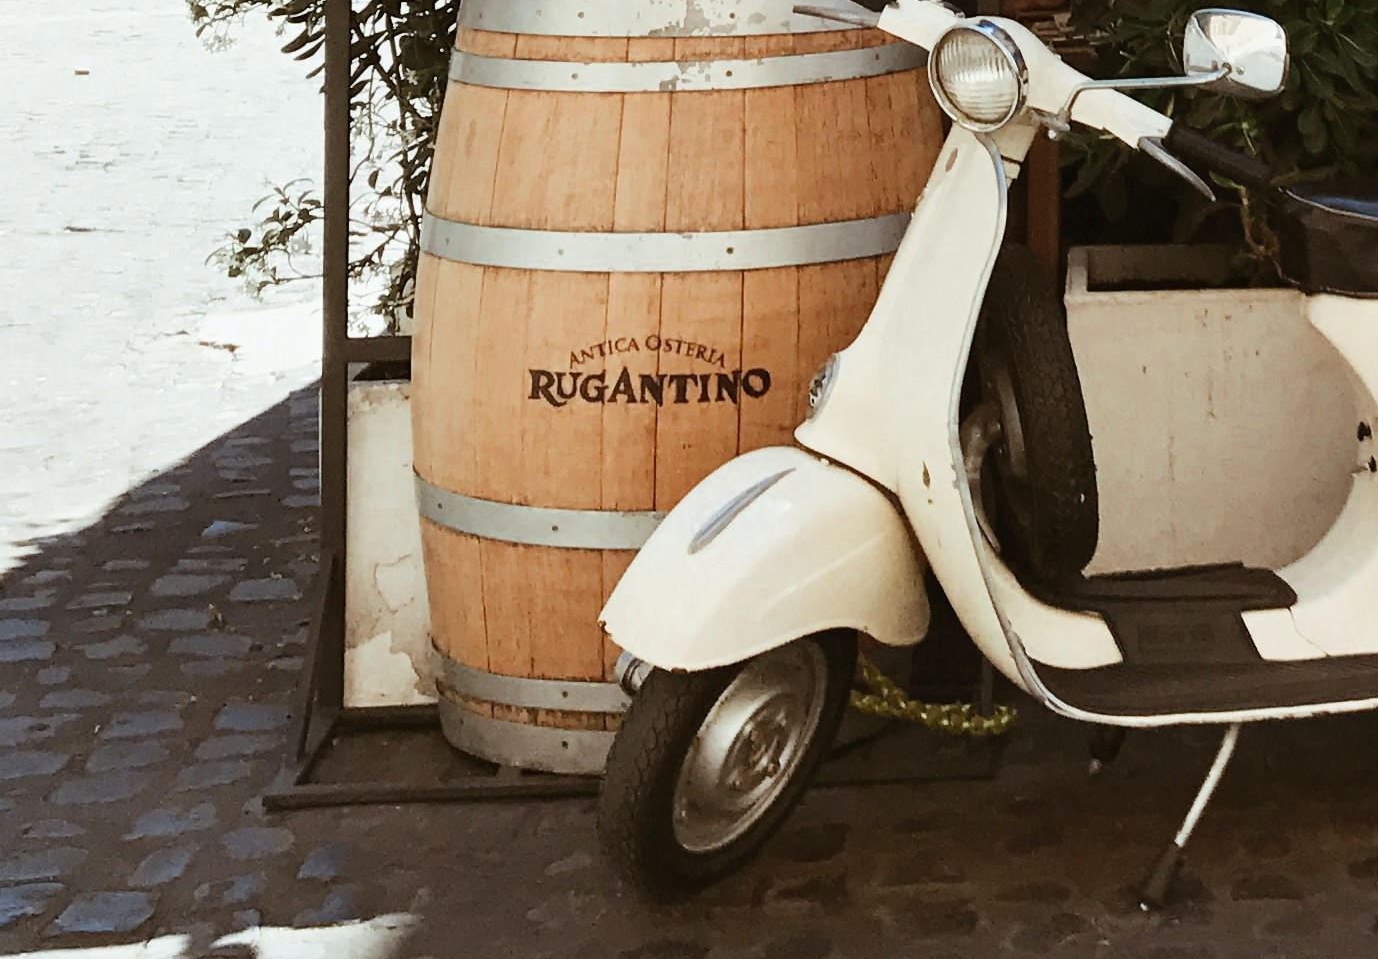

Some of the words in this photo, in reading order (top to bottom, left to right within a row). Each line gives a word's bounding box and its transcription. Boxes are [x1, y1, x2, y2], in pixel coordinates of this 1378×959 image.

[570, 337, 640, 369] ANTICA
[645, 334, 726, 369] OSTERIA
[528, 366, 771, 408] RUGANTINO
